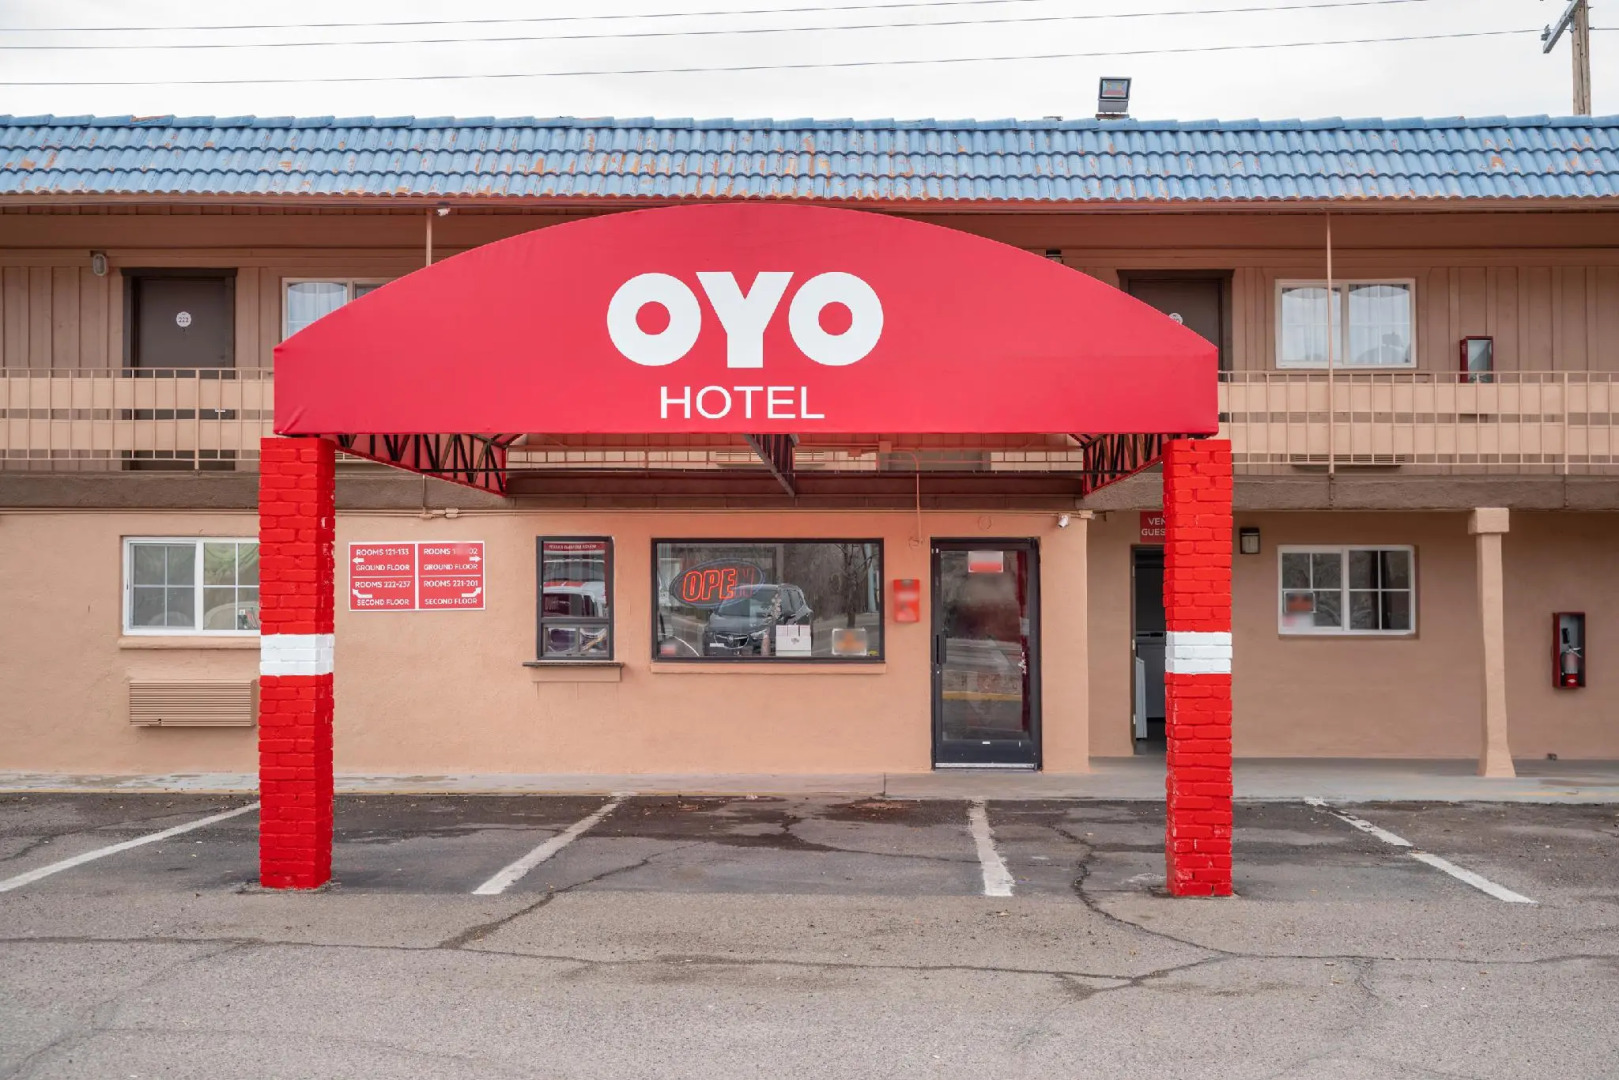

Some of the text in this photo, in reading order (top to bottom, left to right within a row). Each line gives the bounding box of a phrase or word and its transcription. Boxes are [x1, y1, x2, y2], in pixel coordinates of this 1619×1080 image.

[606, 271, 884, 368] OYO
[660, 385, 825, 419] HOTEL
[682, 567, 755, 602] OPEN
